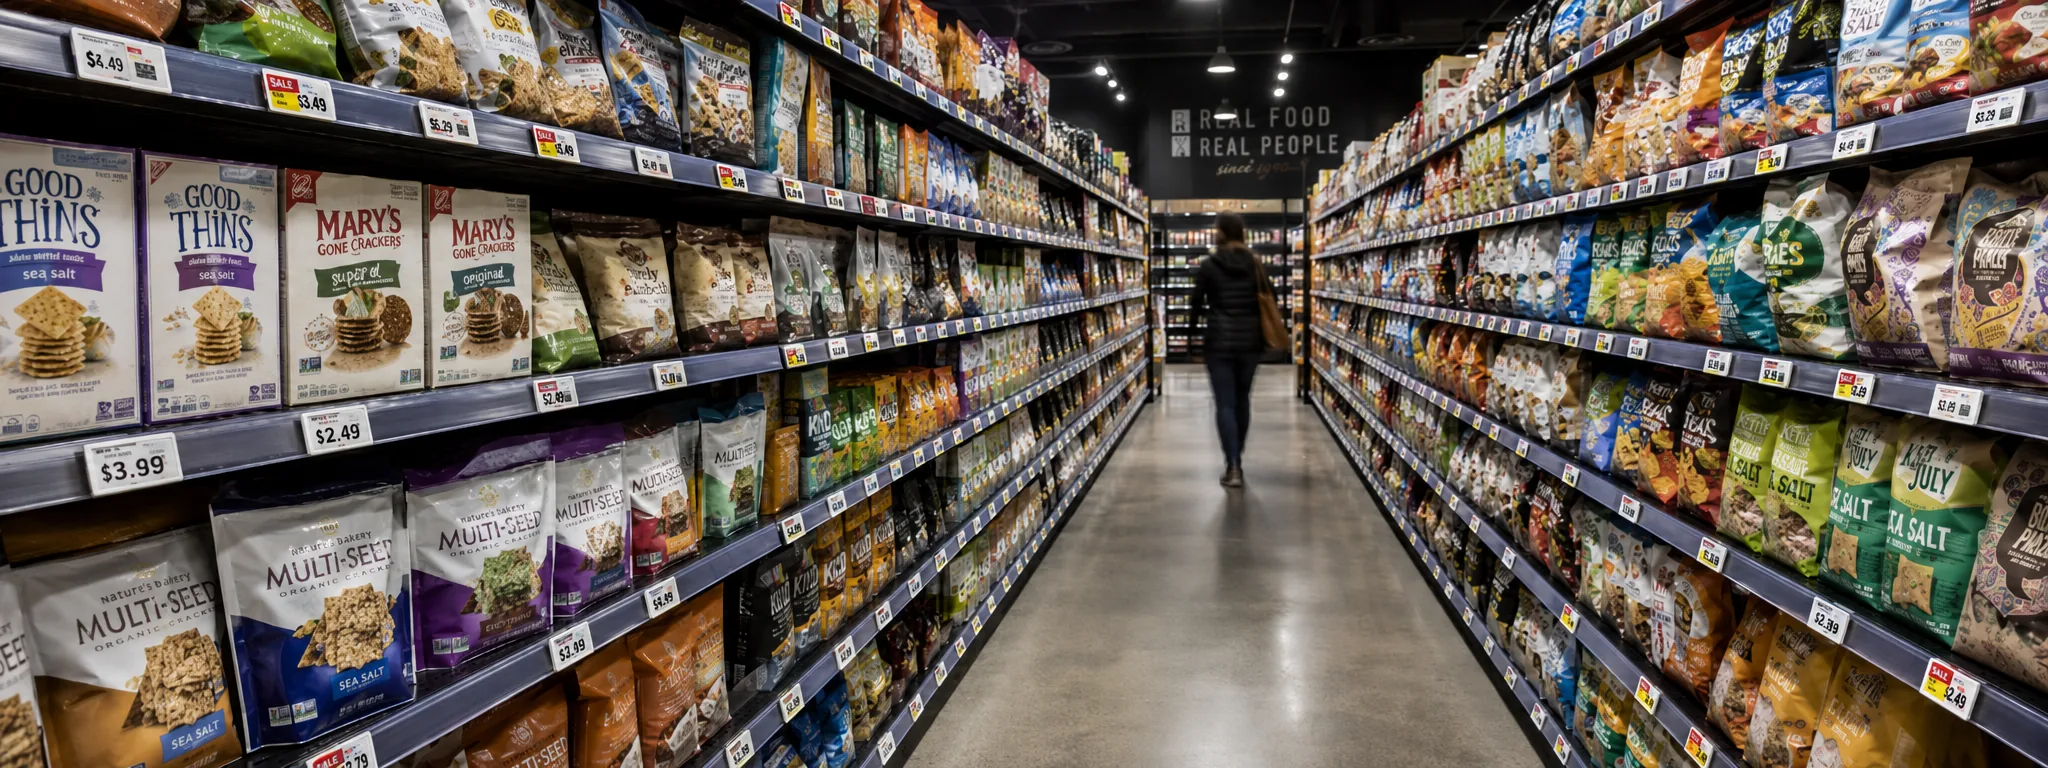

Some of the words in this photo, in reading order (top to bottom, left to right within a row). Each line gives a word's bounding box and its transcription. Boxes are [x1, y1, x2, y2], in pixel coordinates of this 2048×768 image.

[1270, 106, 1331, 127] FOOD
[1200, 137, 1250, 157] REAL
[1261, 134, 1339, 155] PEOPLE
[1216, 161, 1252, 176] since
[5, 167, 83, 198] GOOD
[185, 183, 241, 210] GOOD
[316, 204, 402, 242] MARY'S
[452, 214, 515, 248] MARY'S
[317, 241, 348, 256] GONE
[351, 235, 401, 256] CRACKERS
[453, 248, 476, 259] GONE
[23, 268, 47, 280] sea
[51, 266, 76, 280] salt
[316, 422, 360, 445] $2.49
[101, 455, 164, 483] $3.99
[1777, 475, 1816, 503] SALT
[1840, 492, 1872, 521] SALT
[439, 511, 542, 550] MULTI-SEED
[1907, 517, 1951, 551] SALT
[450, 543, 500, 557] ORGANIC
[279, 578, 338, 598] ORGANIC
[793, 564, 819, 598] KIND
[94, 625, 160, 651] ORGANIC
[339, 677, 358, 691] SEA
[361, 665, 385, 683] SALT
[1944, 686, 1967, 709] $2.49
[171, 733, 193, 751] SEA
[195, 719, 220, 739] SALT
